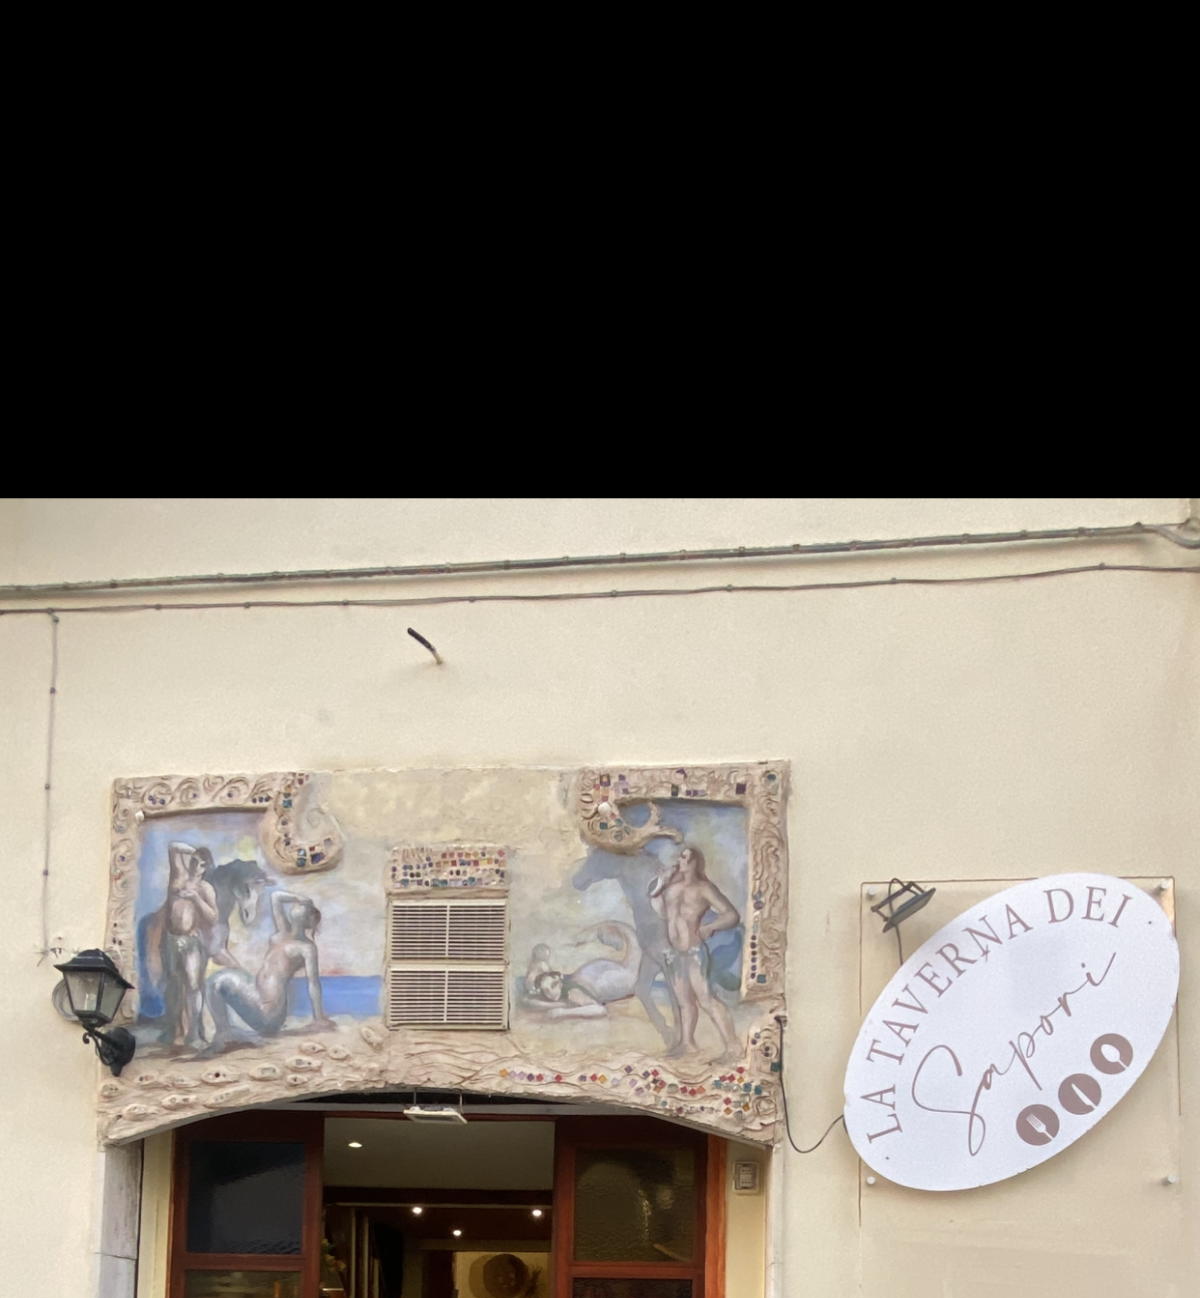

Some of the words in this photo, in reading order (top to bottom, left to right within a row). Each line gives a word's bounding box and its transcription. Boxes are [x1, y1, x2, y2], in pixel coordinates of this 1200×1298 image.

[1043, 886, 1133, 928] DEI
[865, 903, 1034, 1065] TAVERNA
[912, 952, 1117, 1156] Sapori
[860, 1084, 903, 1144] LA
